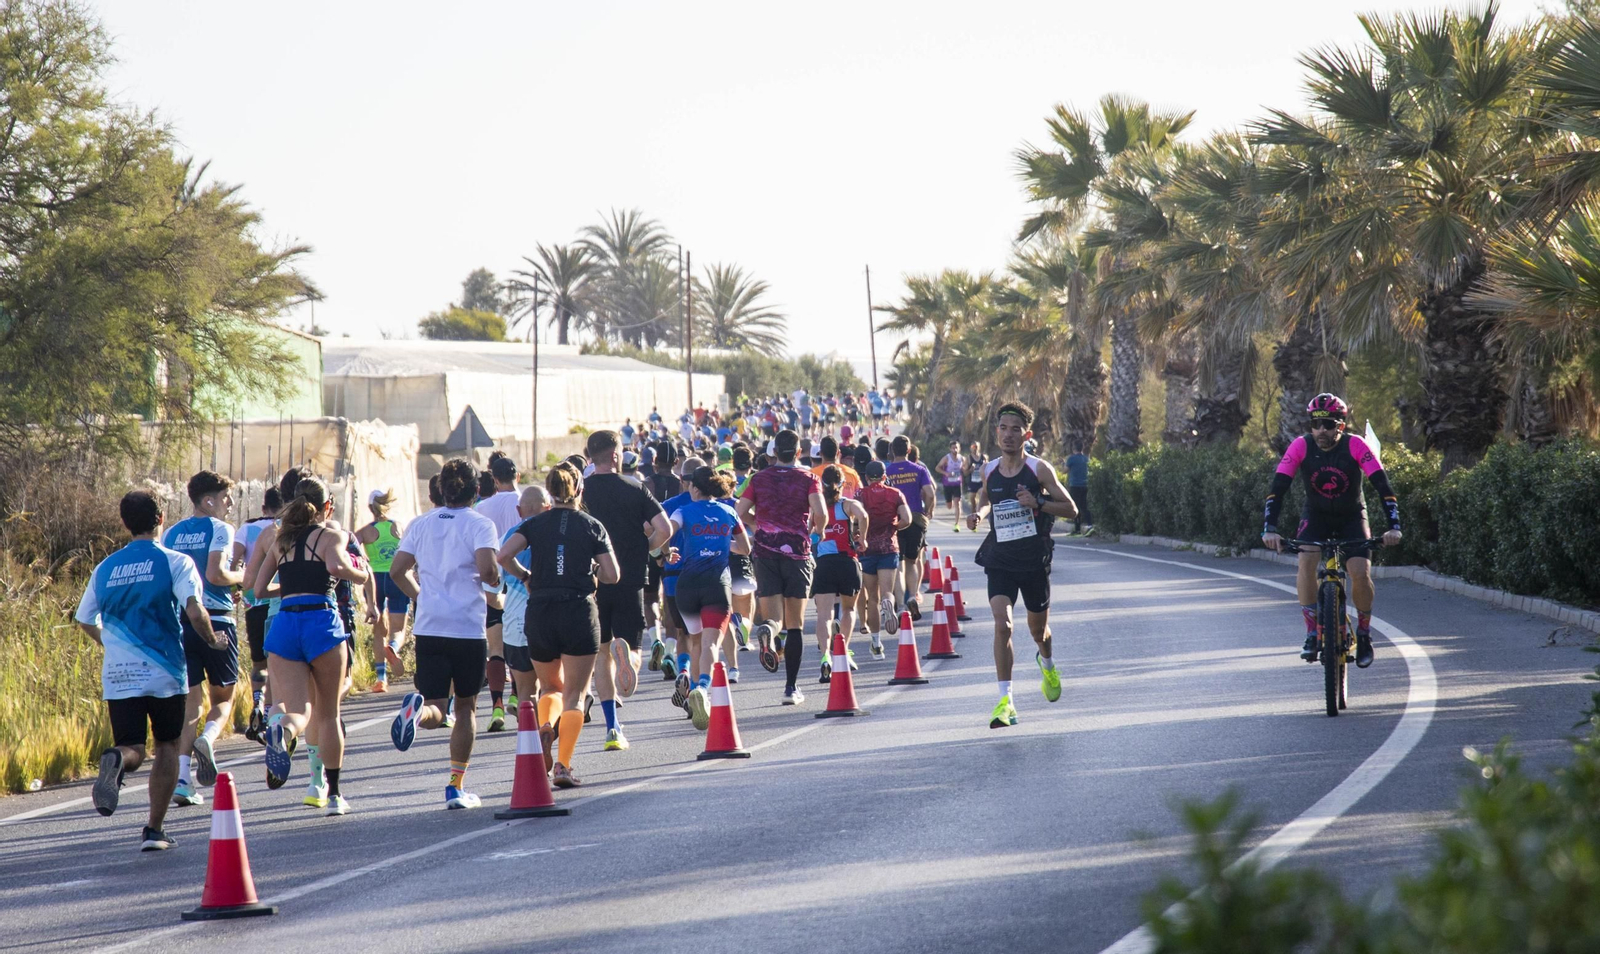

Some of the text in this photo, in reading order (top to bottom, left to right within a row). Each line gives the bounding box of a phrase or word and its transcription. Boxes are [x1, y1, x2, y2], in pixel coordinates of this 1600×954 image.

[887, 472, 918, 480] APADORES
[996, 509, 1031, 521] YOUNESS
[109, 558, 154, 580] ALMERÍA
[136, 574, 154, 583] ASFALTO
